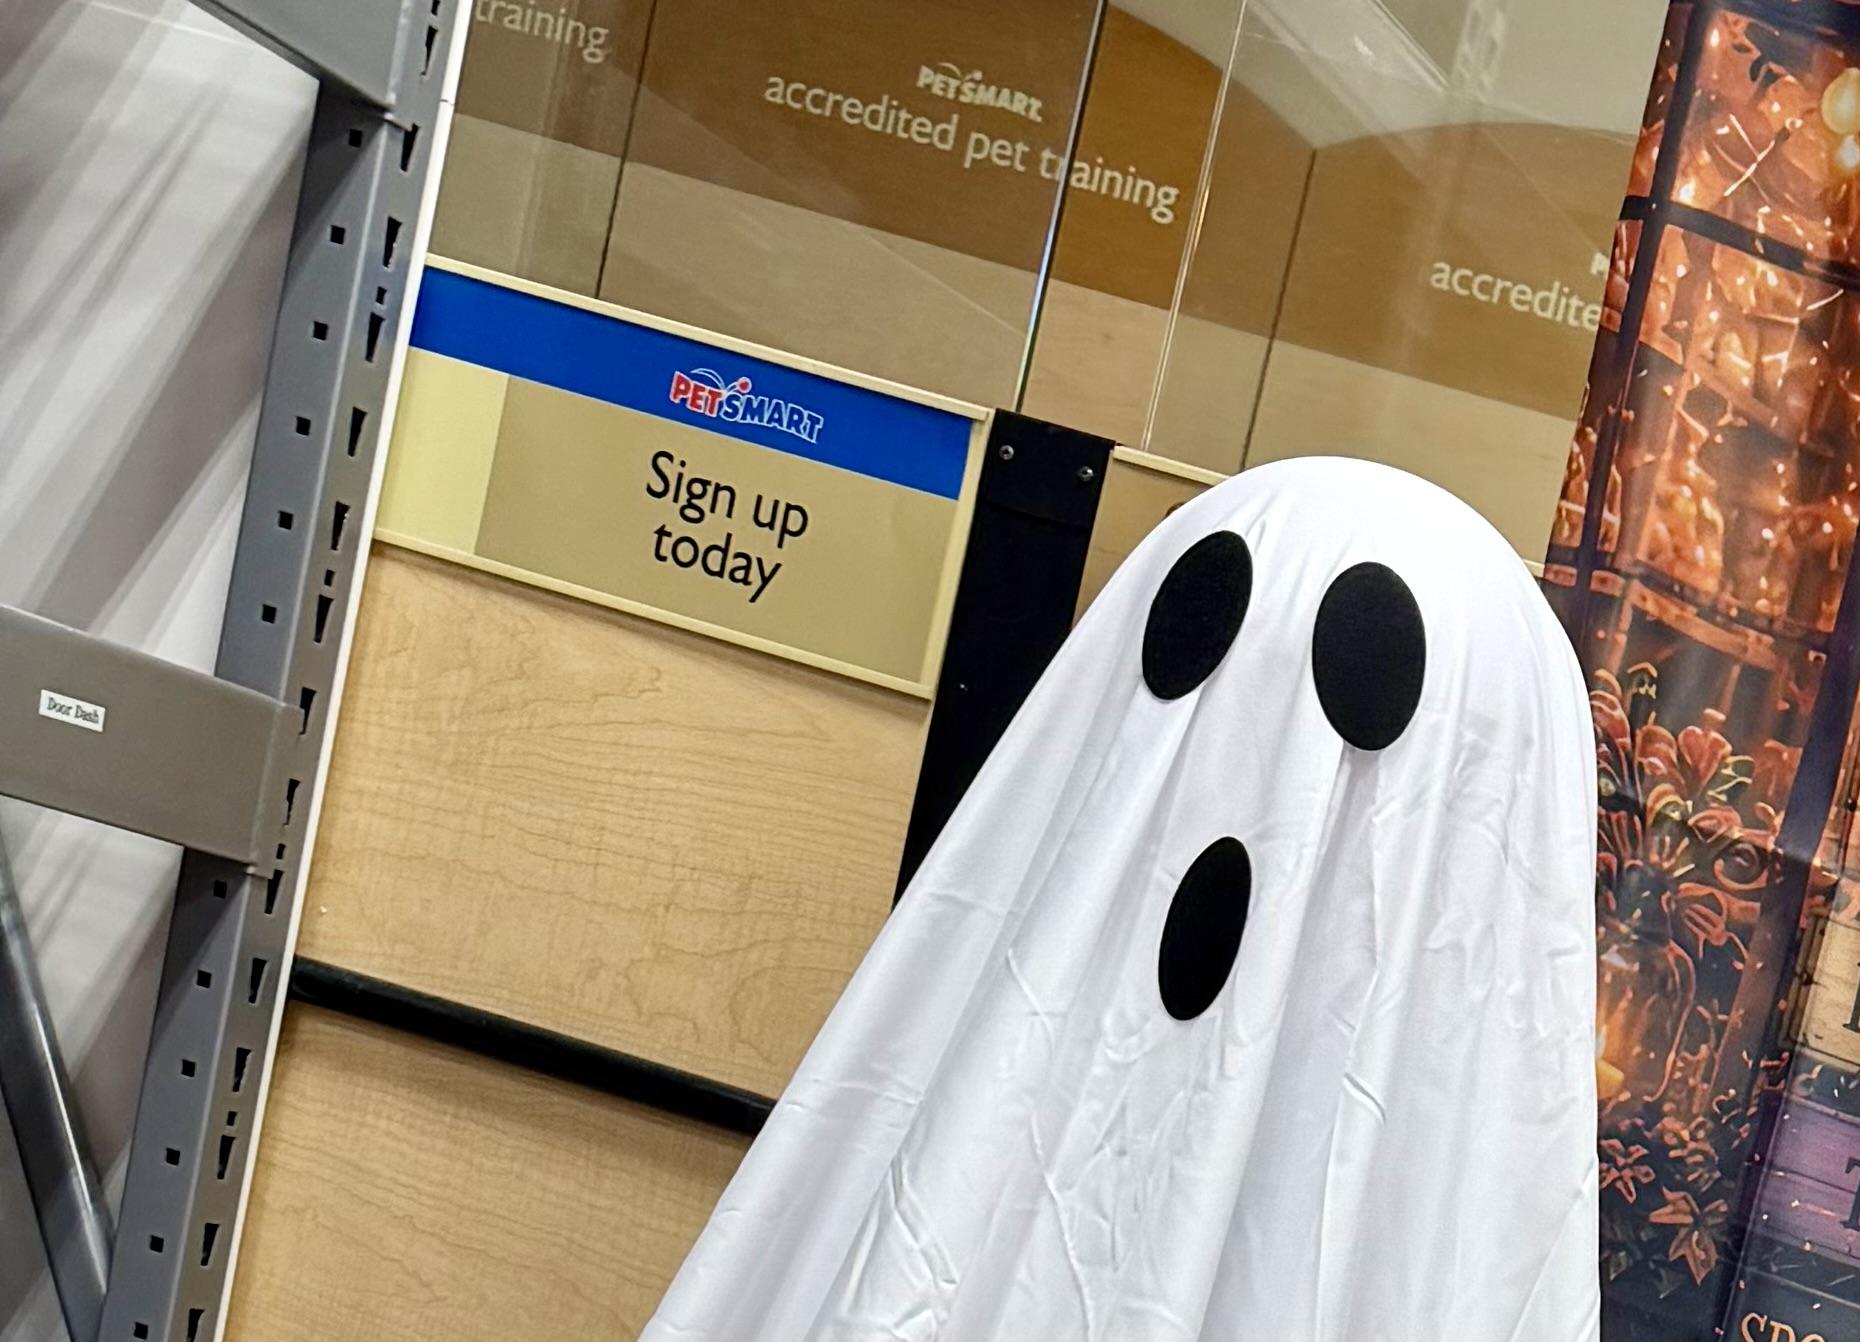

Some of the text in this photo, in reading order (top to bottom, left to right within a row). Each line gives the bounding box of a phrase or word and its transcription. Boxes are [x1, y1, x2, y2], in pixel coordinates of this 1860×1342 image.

[476, 0, 609, 63] training
[763, 76, 960, 151] accredited
[963, 131, 1031, 169] pet
[1430, 261, 1602, 332] accredite
[646, 450, 809, 548] Sign up
[653, 524, 782, 603] today
